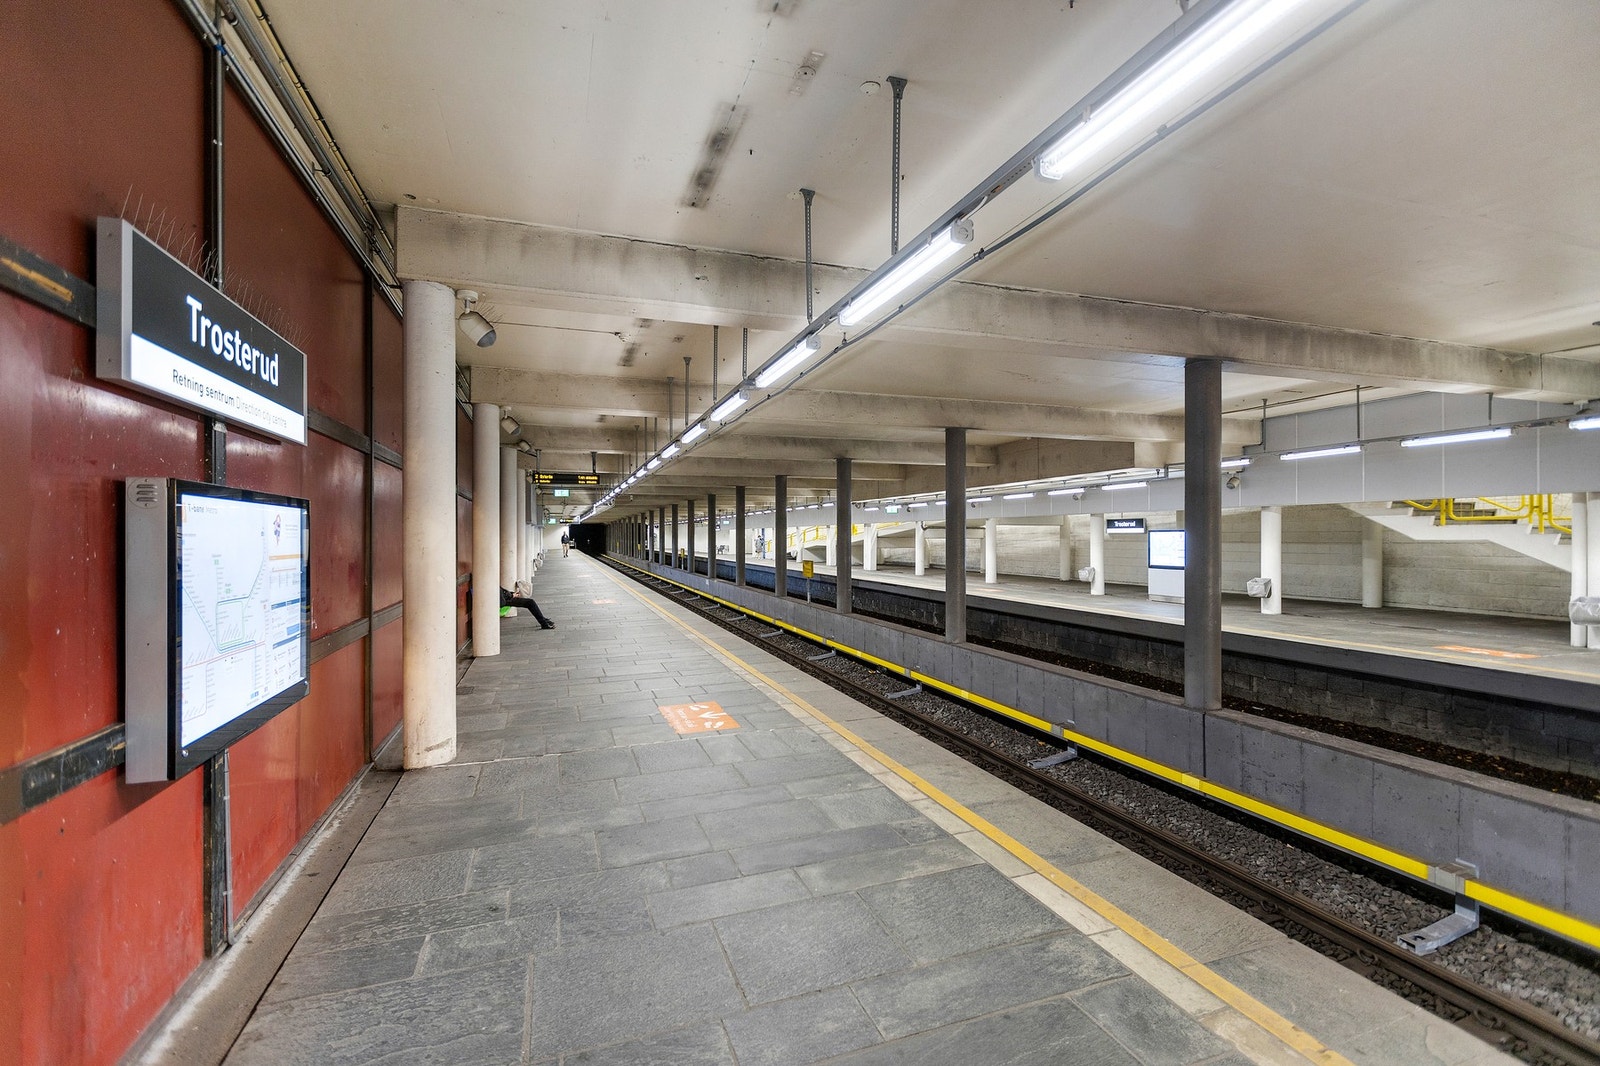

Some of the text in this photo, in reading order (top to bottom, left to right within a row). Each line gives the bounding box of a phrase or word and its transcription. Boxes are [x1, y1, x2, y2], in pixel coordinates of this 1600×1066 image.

[186, 295, 279, 387] Trosterud
[173, 368, 204, 397] Retning
[205, 385, 235, 407] sentrum
[236, 396, 261, 418] Direction
